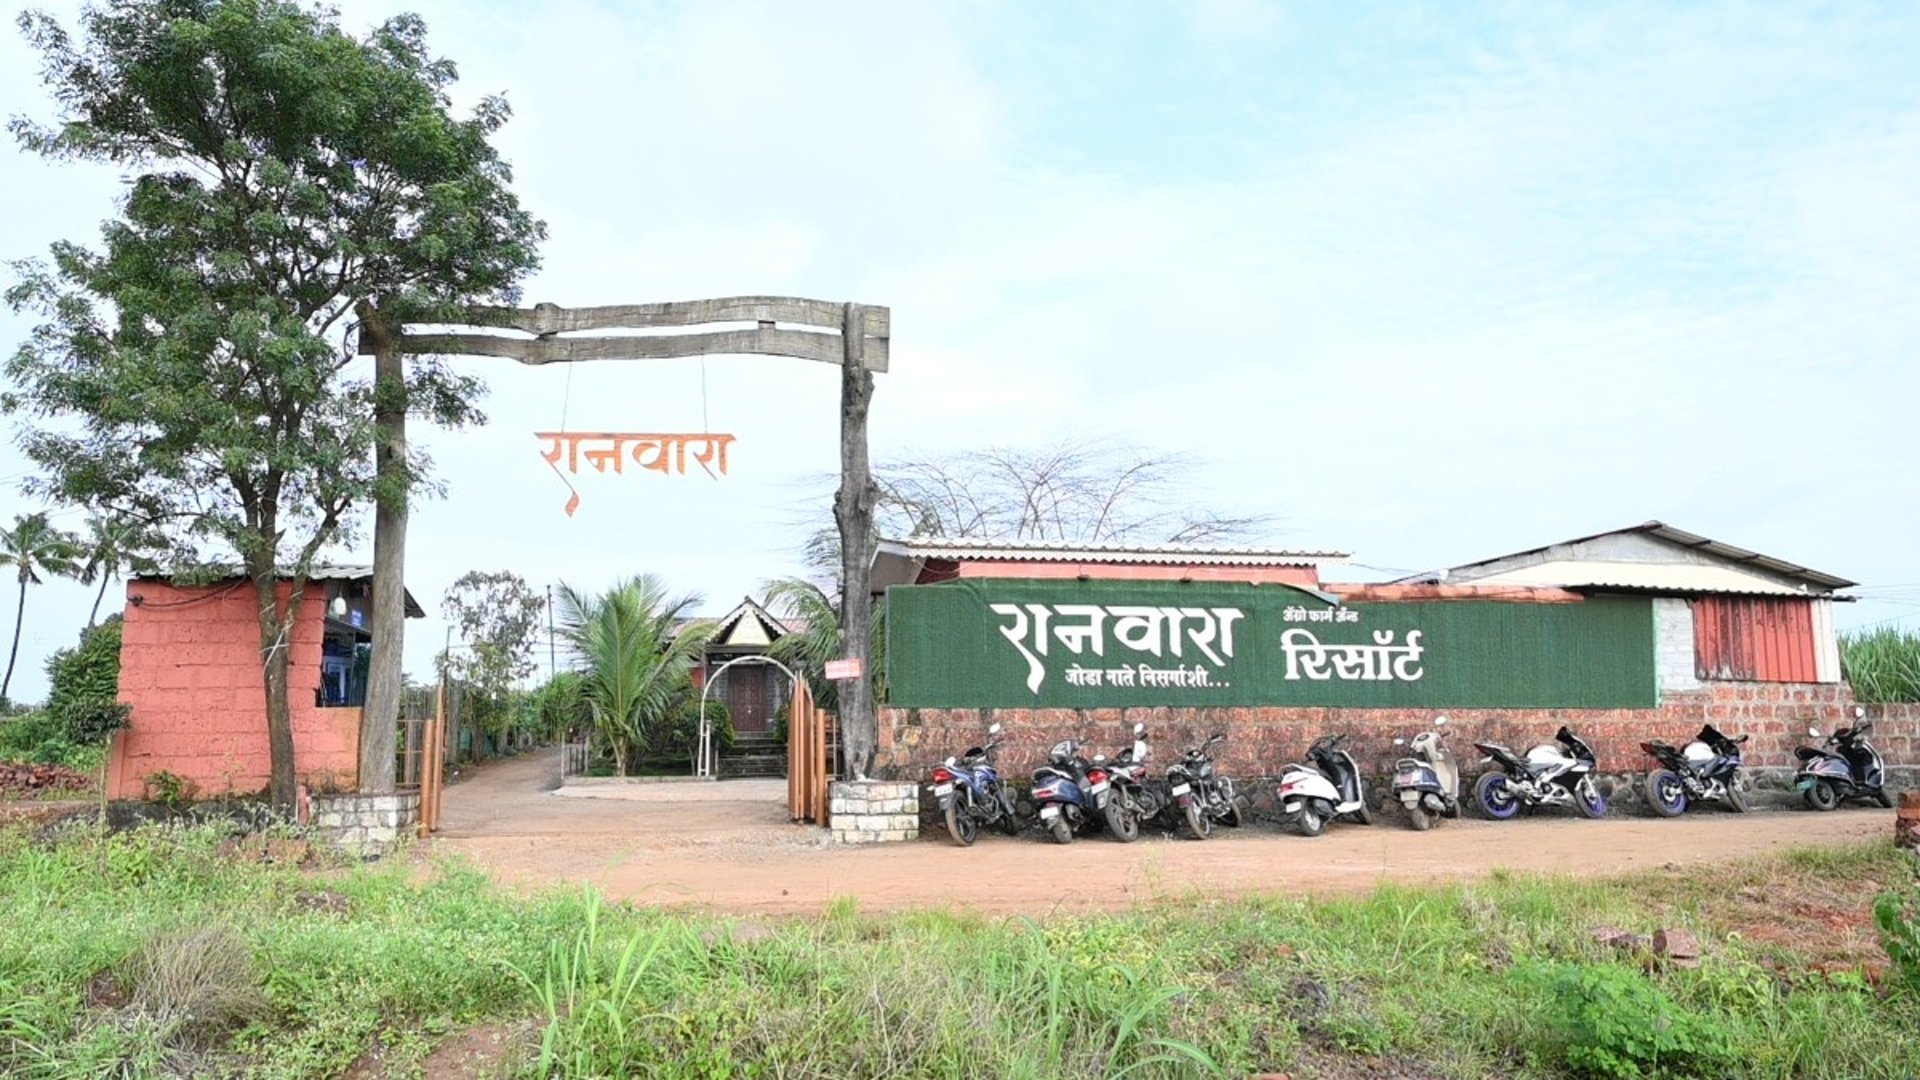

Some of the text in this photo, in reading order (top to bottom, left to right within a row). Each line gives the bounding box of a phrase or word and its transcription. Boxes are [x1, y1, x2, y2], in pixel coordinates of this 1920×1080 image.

[533, 432, 737, 517] रानवारा
[990, 604, 1244, 694] रानवारा
[1065, 663, 1103, 686] जोडा
[1105, 664, 1136, 686] नाते
[1280, 628, 1424, 681] रिसॉर्ट
